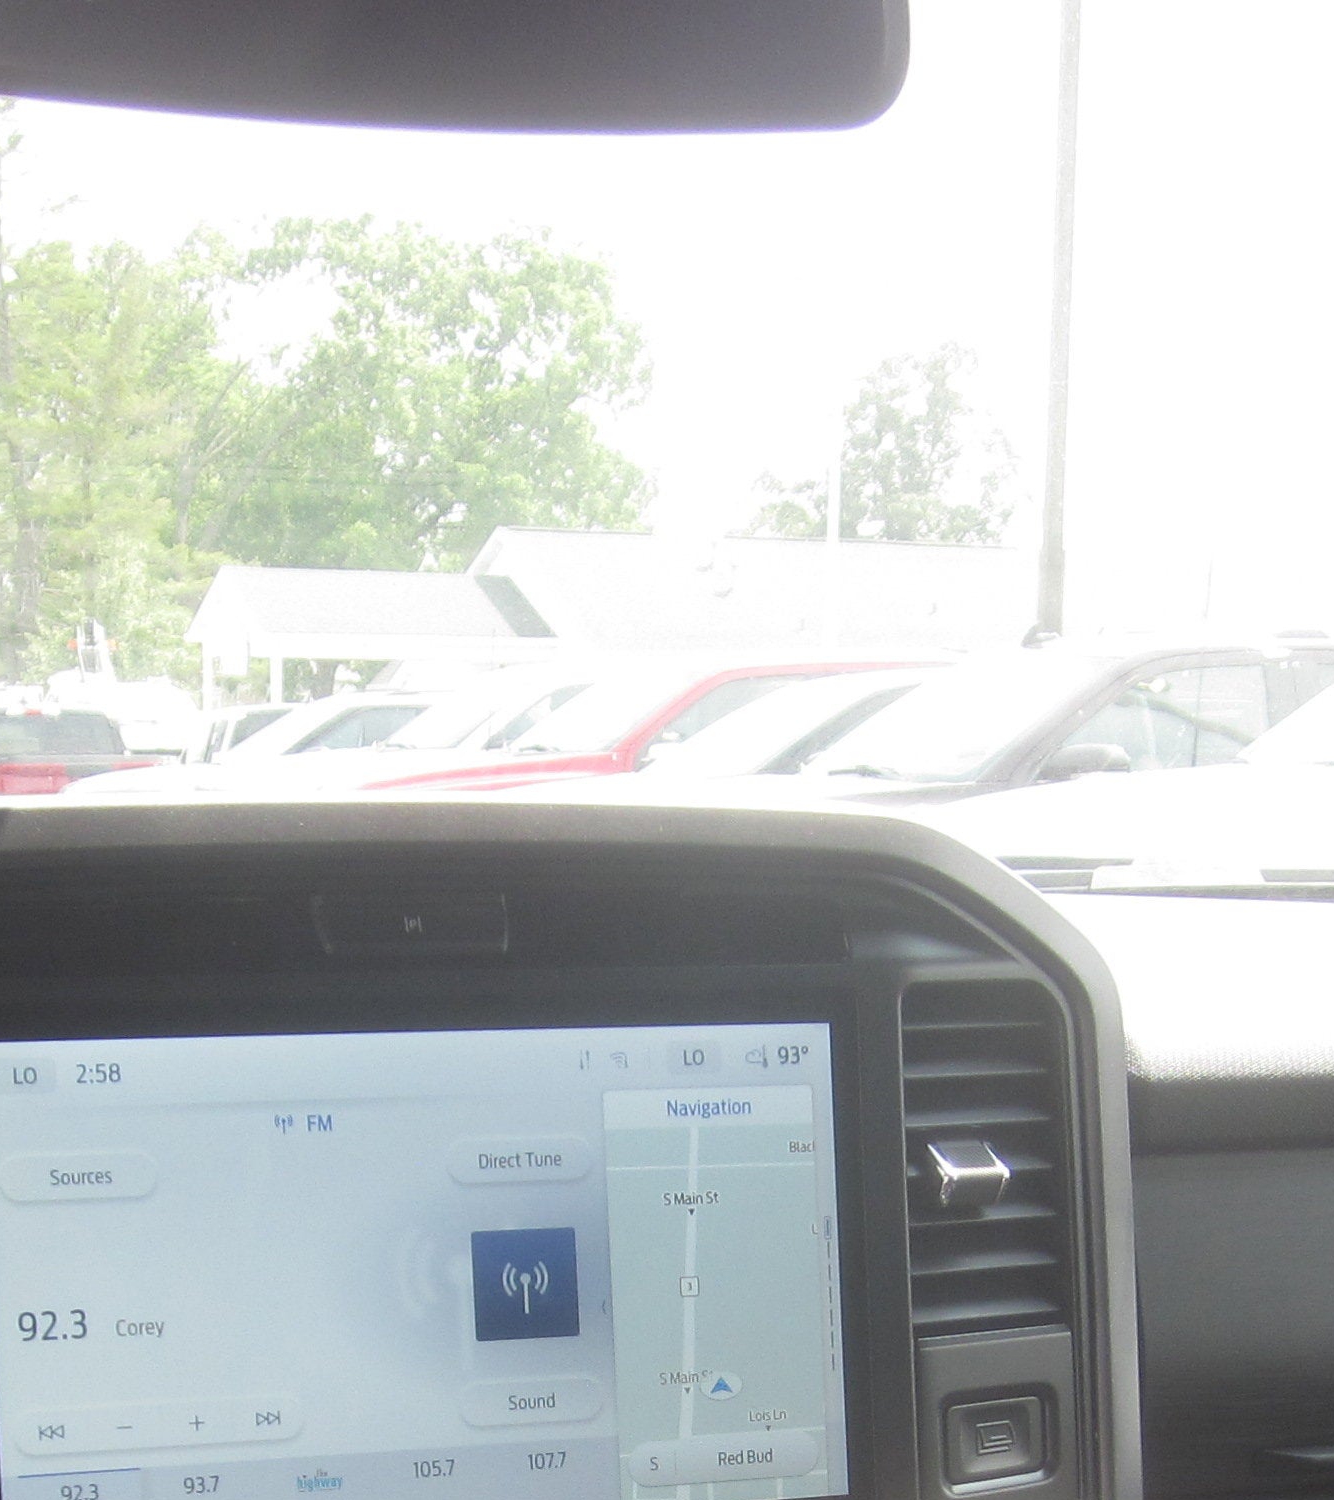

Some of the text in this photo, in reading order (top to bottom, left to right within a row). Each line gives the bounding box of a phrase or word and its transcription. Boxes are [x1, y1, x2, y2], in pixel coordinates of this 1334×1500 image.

[682, 1049, 705, 1067] LO
[777, 1045, 809, 1066] 93°
[12, 1066, 37, 1085] LO
[75, 1063, 121, 1085] 2:58
[666, 1098, 752, 1119] Navigation
[307, 1114, 333, 1132] FM
[477, 1150, 562, 1170] Direct Tune
[49, 1168, 113, 1187] Sources
[663, 1191, 719, 1206] S Main St
[17, 1308, 88, 1341] 92.3
[115, 1318, 164, 1338] Corey
[670, 1372, 699, 1384] Main
[508, 1393, 556, 1411] Sound
[749, 1409, 787, 1422] Lois Ln
[413, 1459, 455, 1479] 105.7
[527, 1451, 566, 1471] 107.7
[650, 1448, 773, 1471] S Red Bud
[183, 1475, 219, 1495] 93.7
